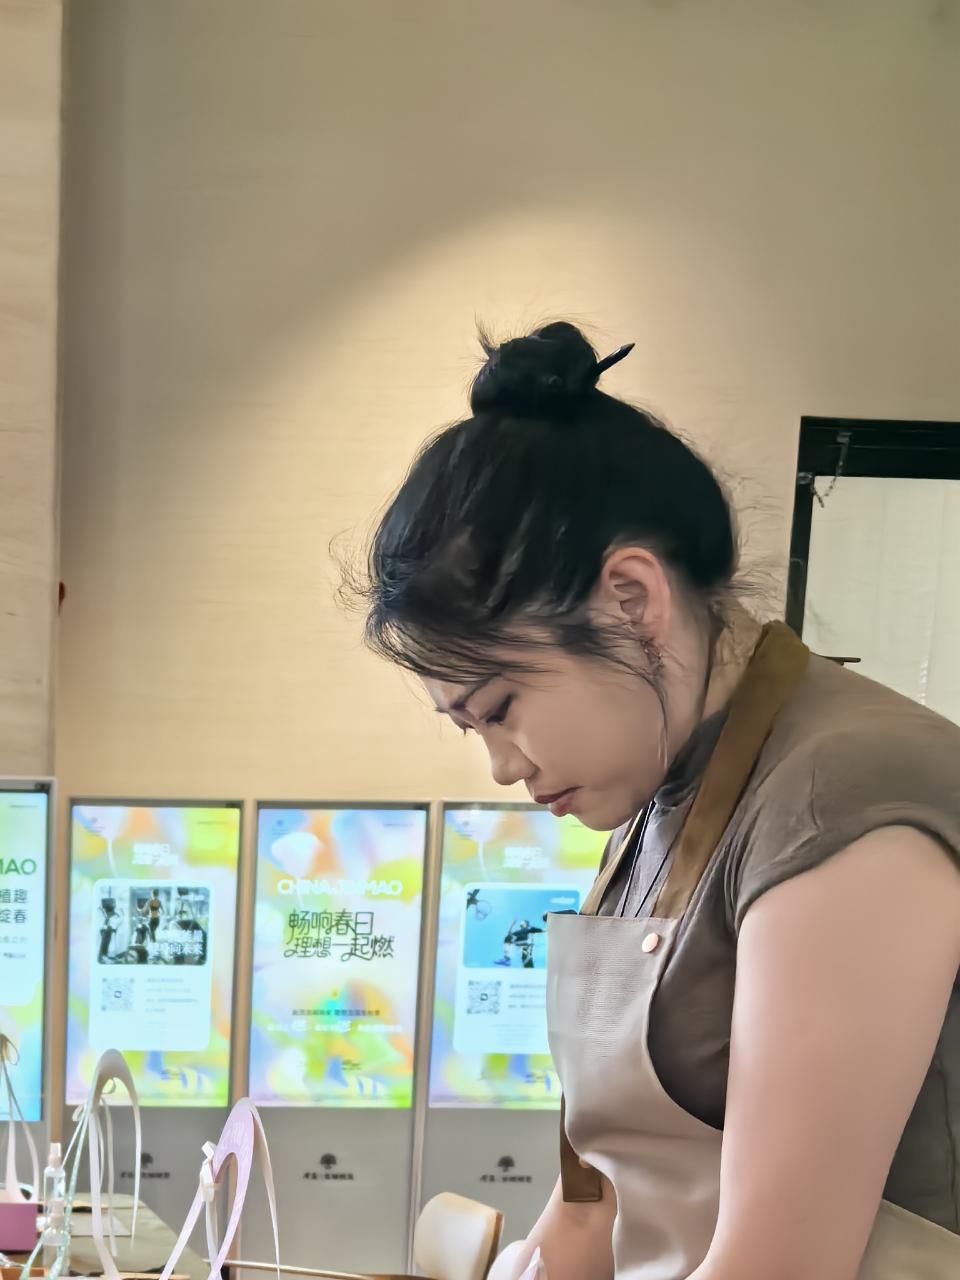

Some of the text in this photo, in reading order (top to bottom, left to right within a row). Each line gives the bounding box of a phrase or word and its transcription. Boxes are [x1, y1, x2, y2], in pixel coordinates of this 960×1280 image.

[287, 908, 375, 943] 畅响春日
[283, 935, 395, 962] 理想一起燃
